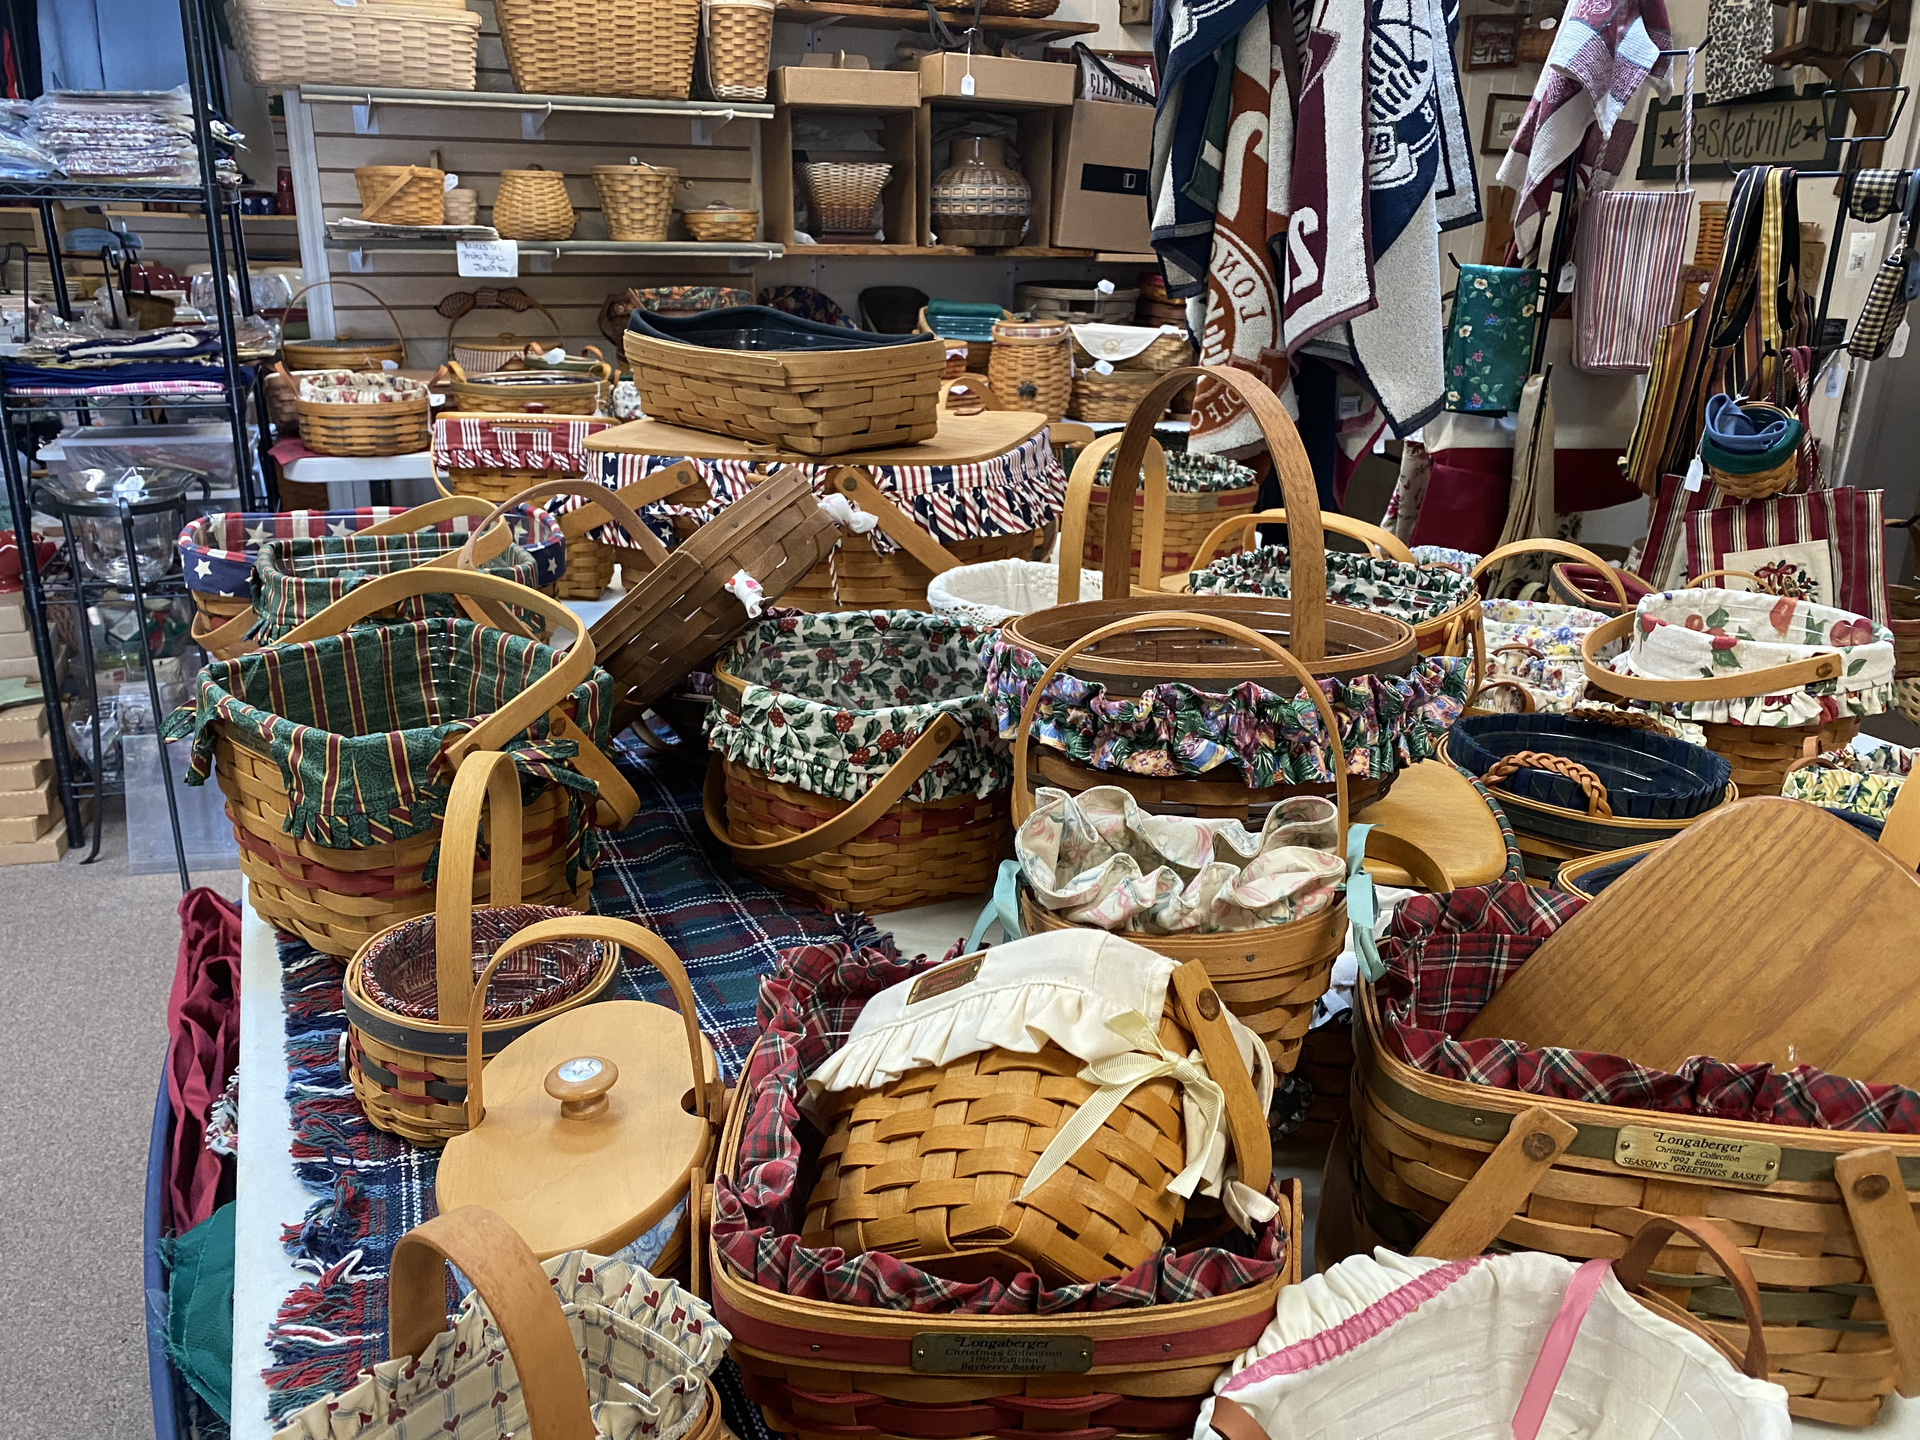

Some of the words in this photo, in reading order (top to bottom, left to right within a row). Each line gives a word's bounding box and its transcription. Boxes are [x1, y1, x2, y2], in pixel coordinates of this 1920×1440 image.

[1653, 1131, 1748, 1154] Longaberger
[1655, 1145, 1695, 1157] Christmas
[1700, 1151, 1741, 1163] Collection
[1669, 1155, 1691, 1165] 1992
[1694, 1158, 1724, 1169] Edition
[1622, 1156, 1669, 1170] SEASON'S
[1673, 1164, 1728, 1178] GREETINGS
[1731, 1171, 1769, 1183] BASKET
[953, 1336, 1055, 1350] Longaberger
[945, 1349, 1003, 1357] Christmas
[1006, 1349, 1062, 1357] Collection
[999, 1356, 1039, 1364] Edition
[960, 1363, 1009, 1373] Bayberry
[1011, 1363, 1047, 1372] Basket
